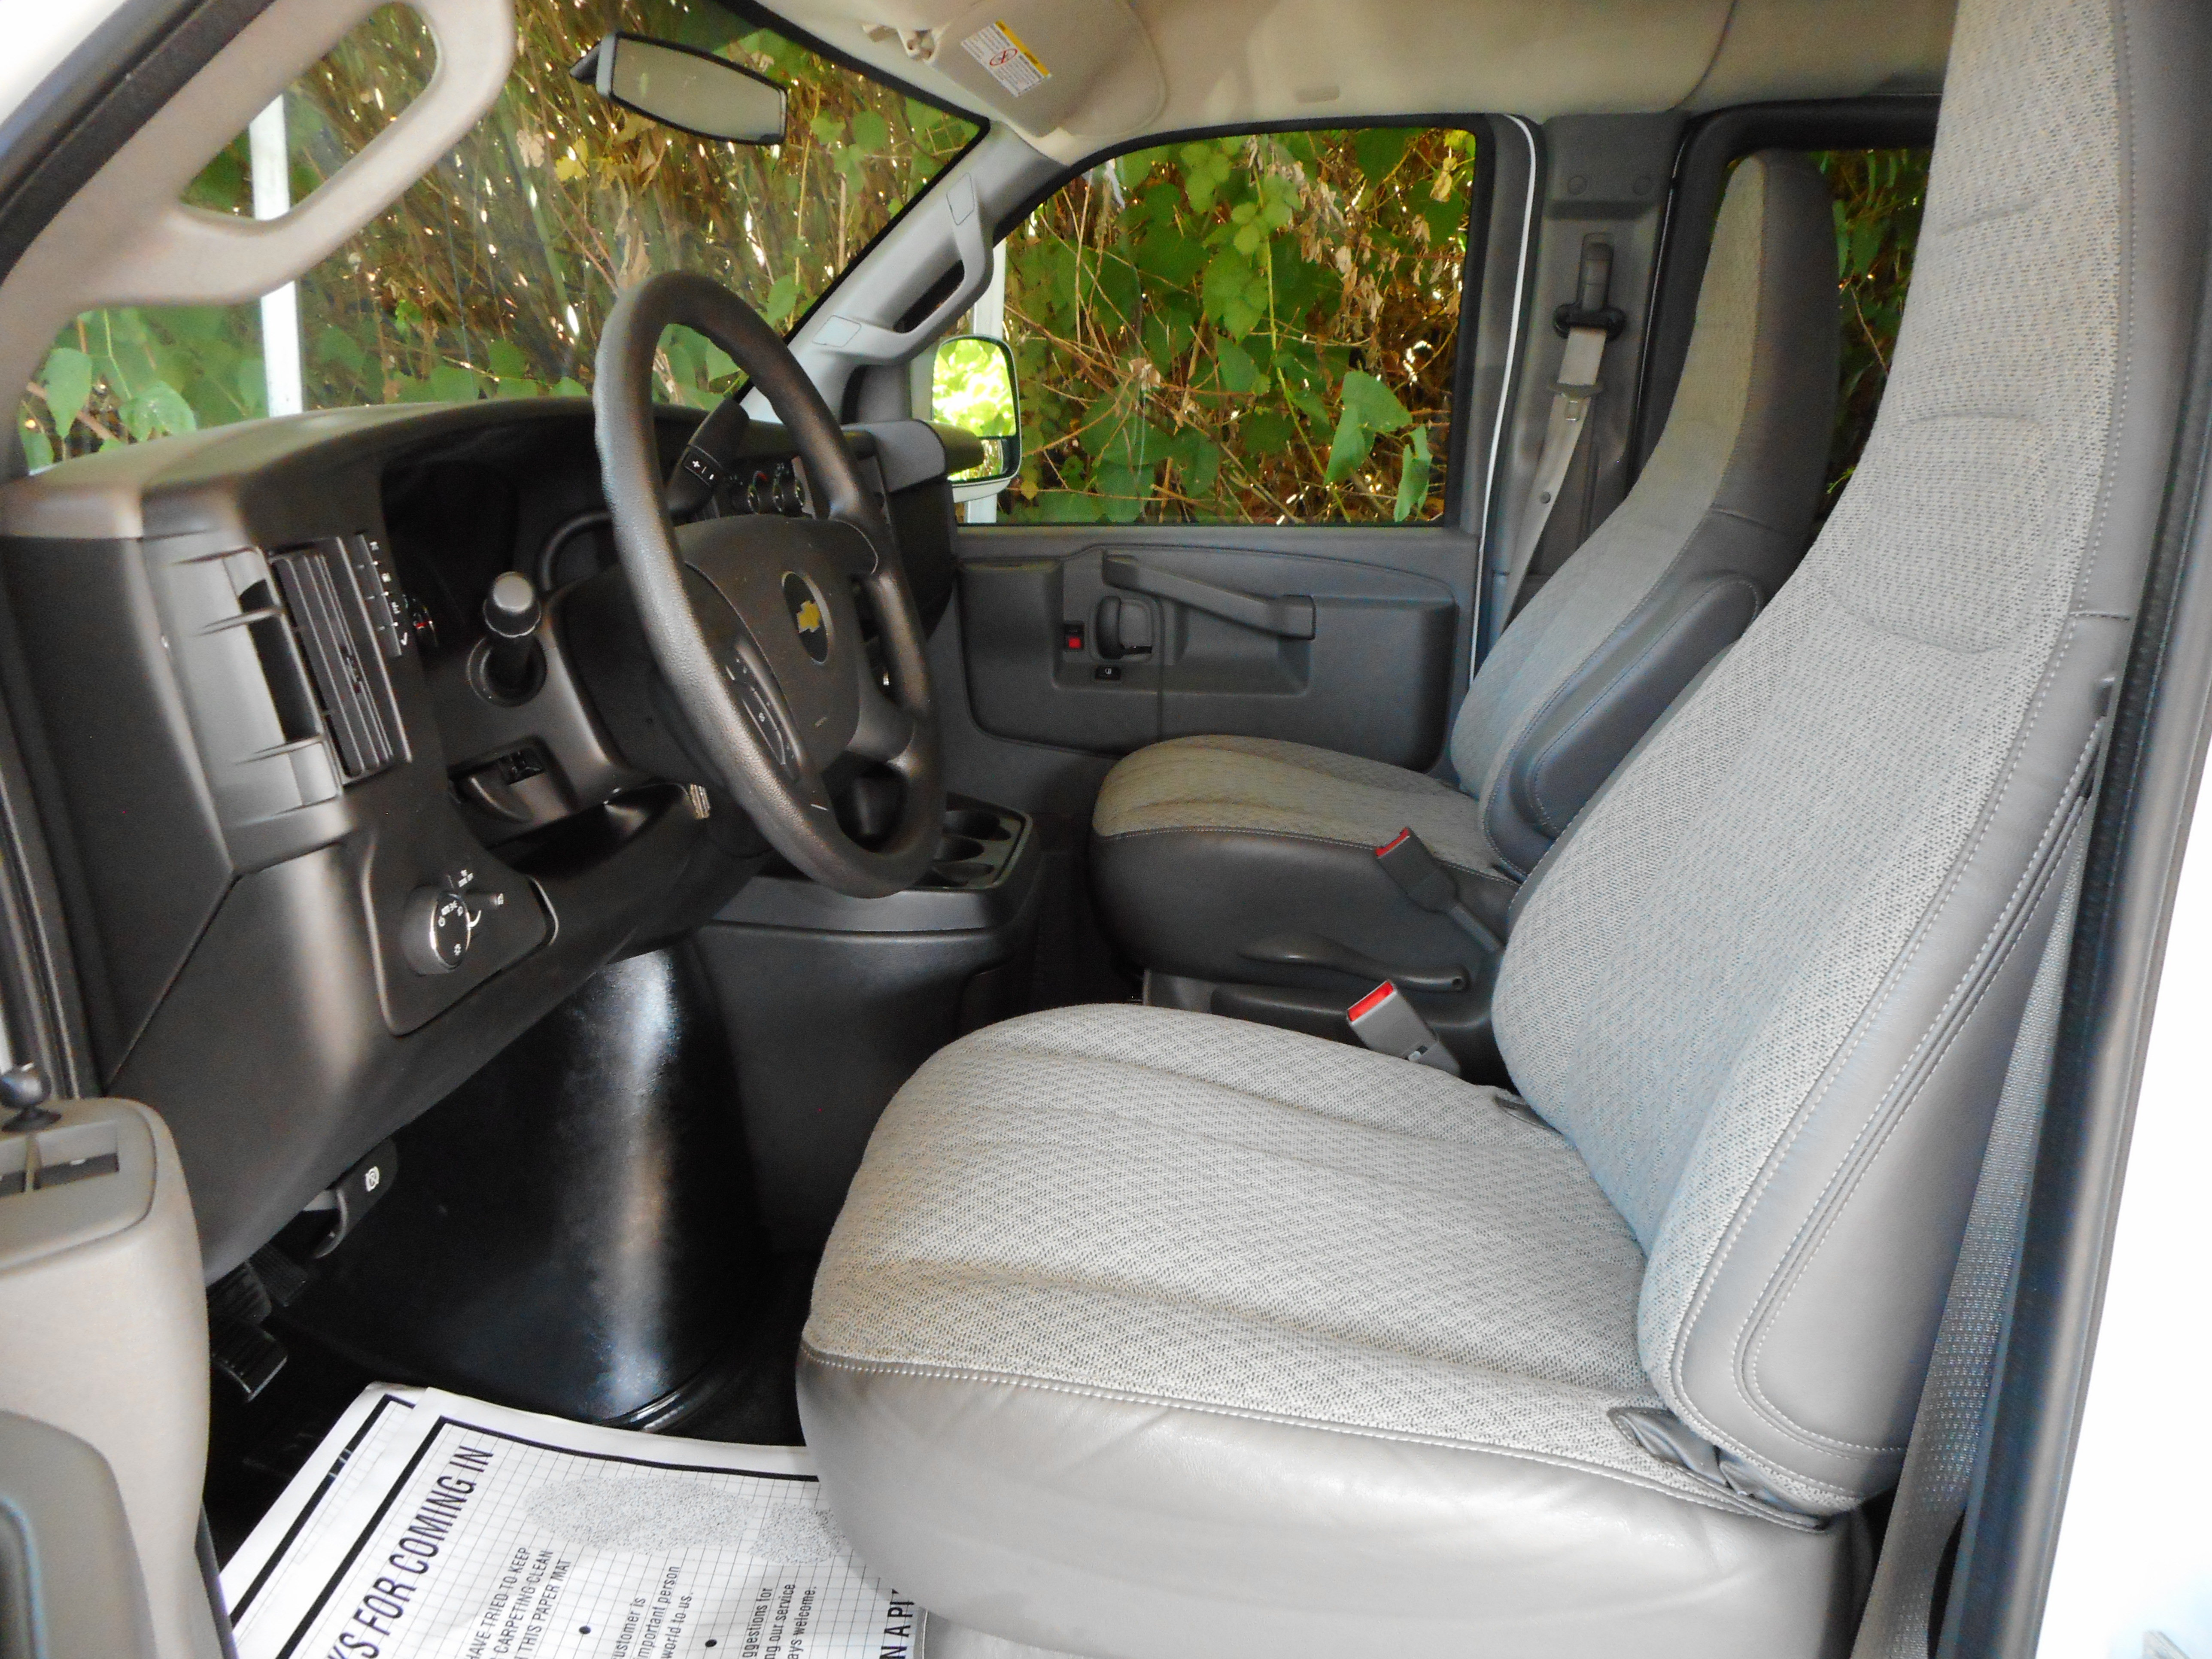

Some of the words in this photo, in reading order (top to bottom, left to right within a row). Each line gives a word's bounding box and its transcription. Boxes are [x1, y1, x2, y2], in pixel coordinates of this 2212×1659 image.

[353, 1577, 417, 1636] FOR
[389, 1476, 477, 1574] COMING
[449, 1445, 494, 1473] IN
[480, 1593, 510, 1627] TRIED
[498, 1576, 518, 1590] TO
[508, 1547, 530, 1574] KEEP
[493, 1586, 535, 1653] CARPETING
[526, 1549, 553, 1583] CLEAN
[518, 1624, 542, 1652] THIS
[532, 1584, 560, 1622] PAPER
[550, 1559, 571, 1582] MAT
[678, 1592, 694, 1609] us.
[756, 1587, 773, 1602] for
[775, 1583, 796, 1621] service
[613, 1611, 641, 1659] ustomer
[629, 1597, 646, 1607] is
[633, 1606, 666, 1659] mportant
[657, 1566, 680, 1604] person
[670, 1613, 686, 1623] to
[769, 1624, 784, 1642] our
[793, 1586, 817, 1636] welcome.
[884, 1625, 911, 1638] A
[661, 1626, 681, 1659] world
